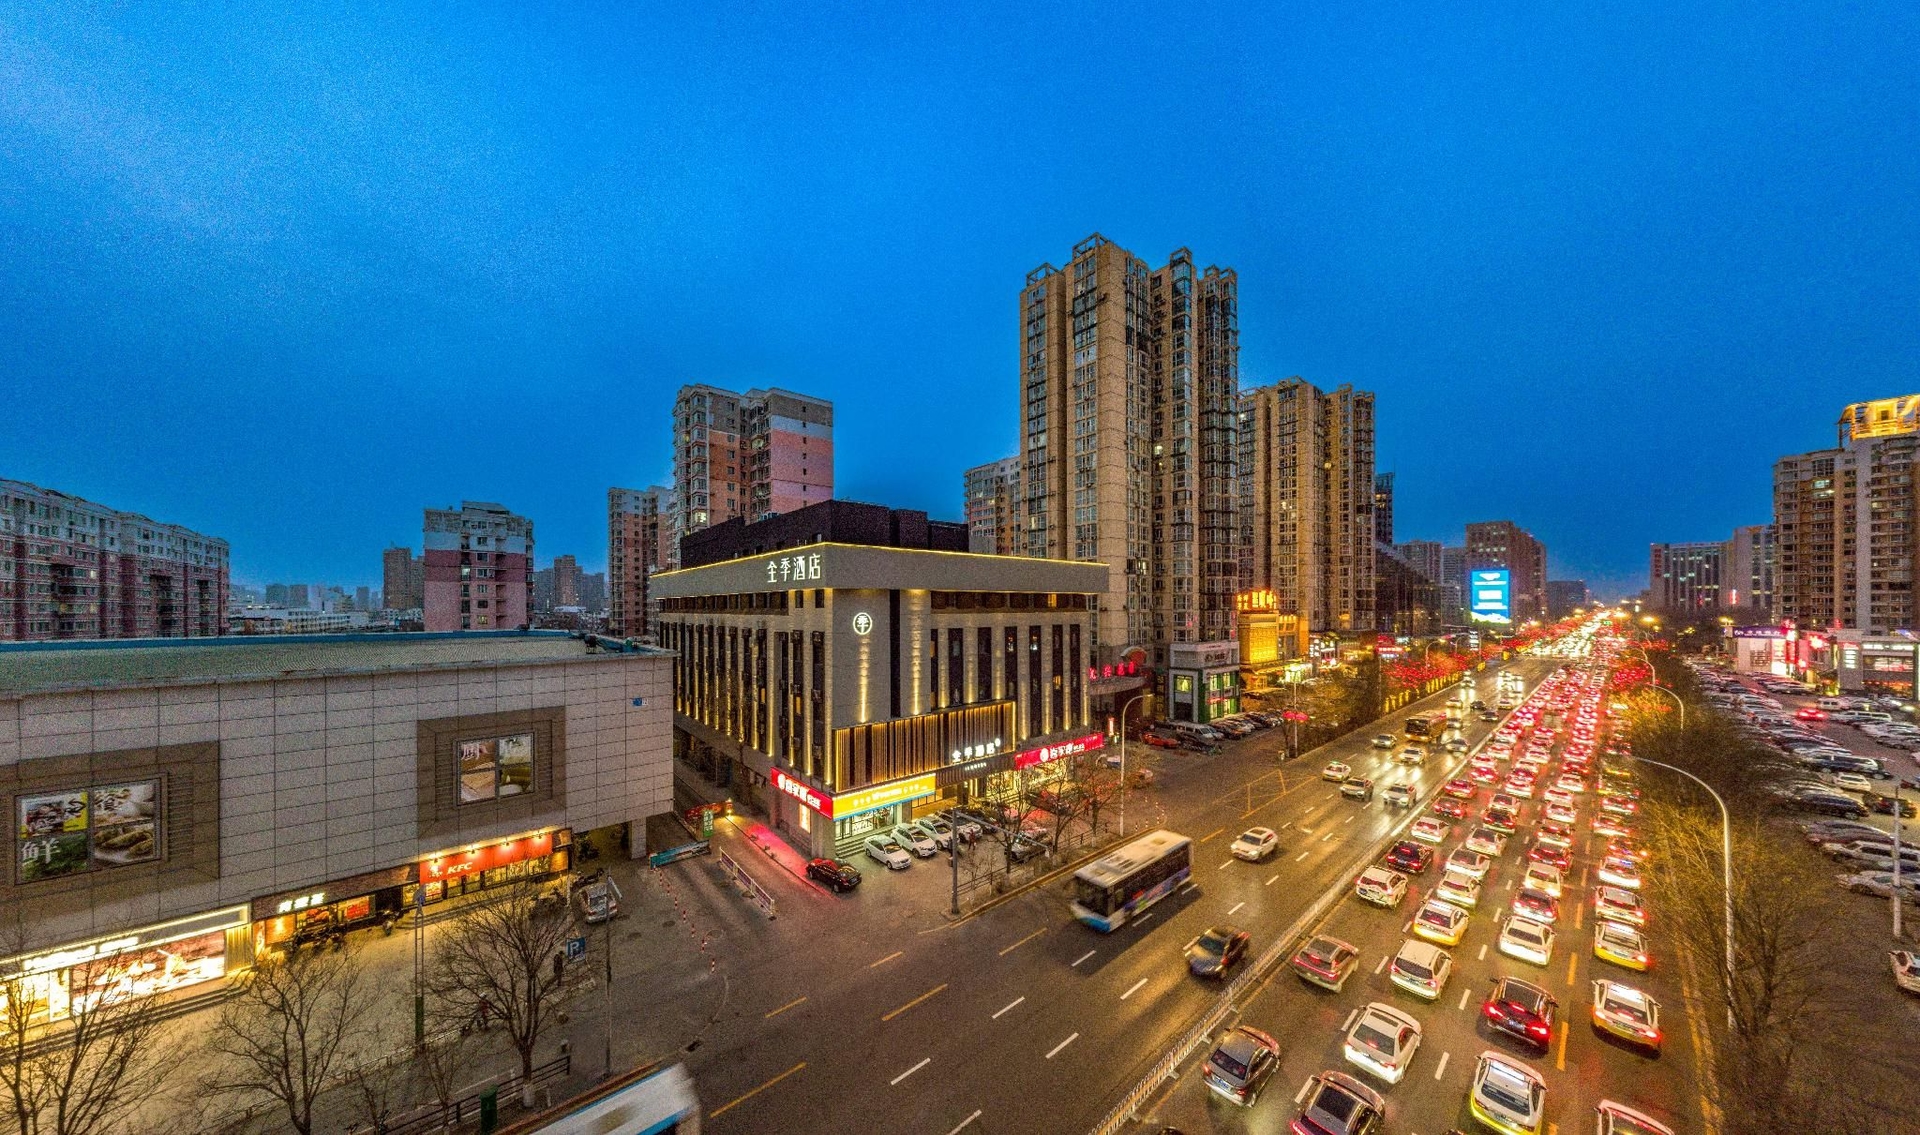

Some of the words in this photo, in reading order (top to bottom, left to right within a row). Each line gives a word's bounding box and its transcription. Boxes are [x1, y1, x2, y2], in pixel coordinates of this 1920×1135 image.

[767, 553, 821, 583] 全季酒店
[447, 862, 473, 875] KFC
[569, 941, 580, 956] P
